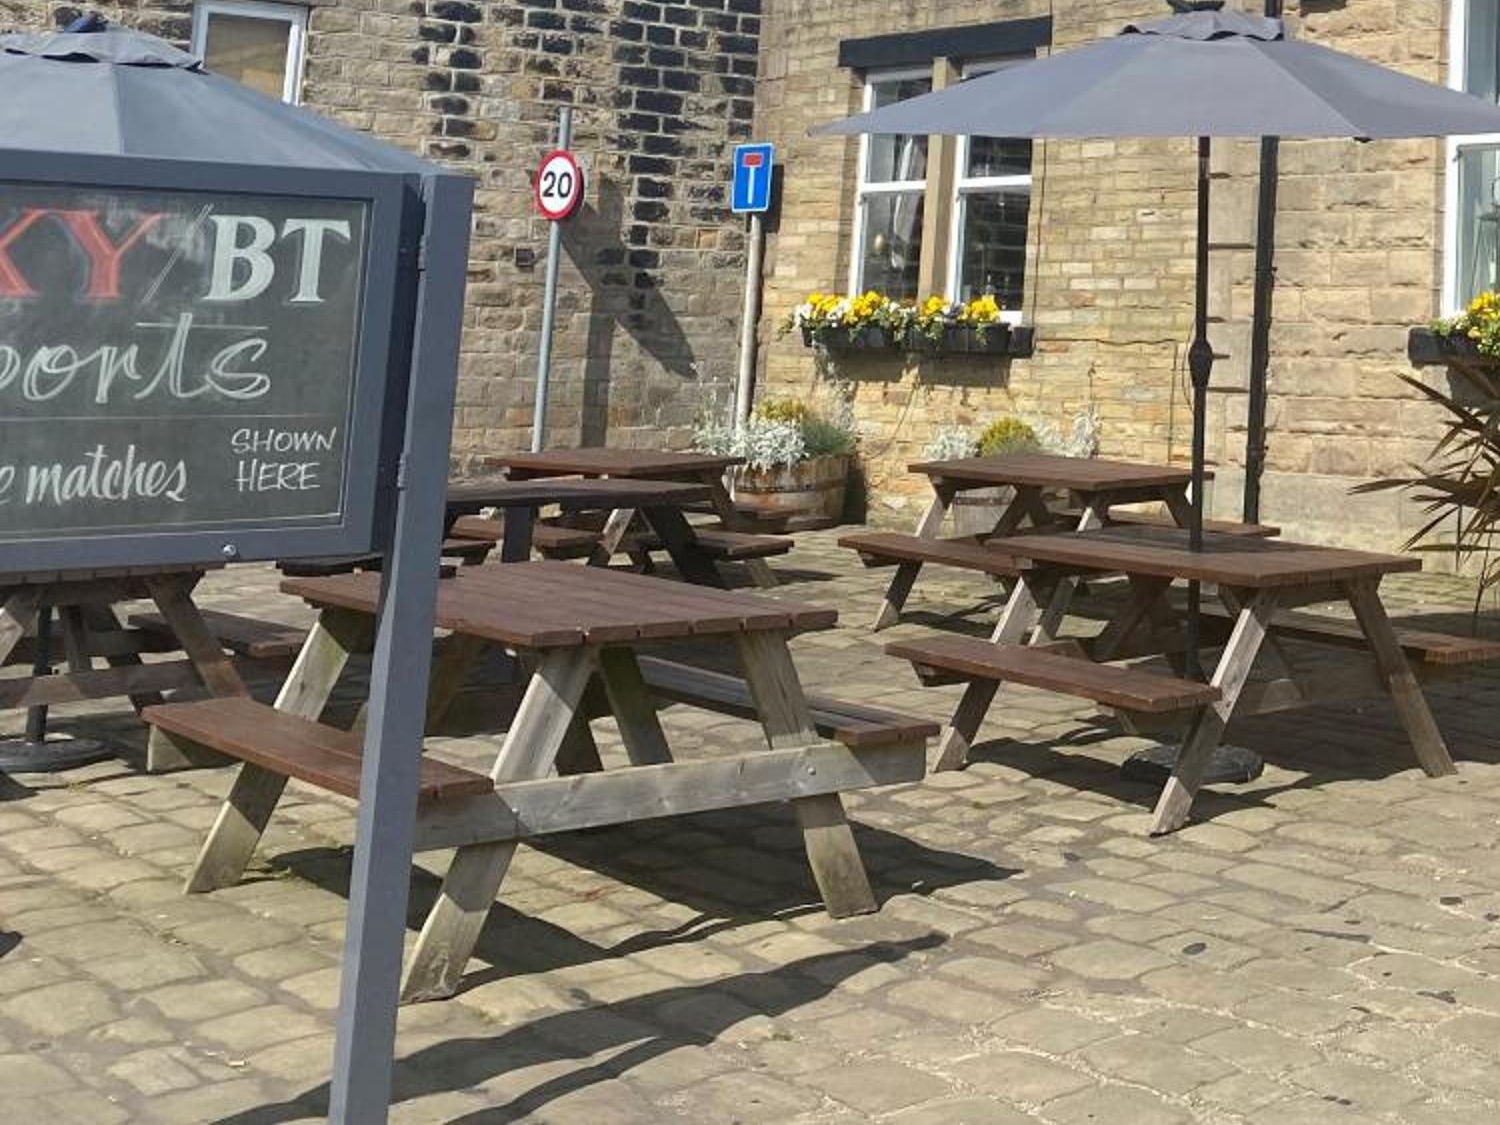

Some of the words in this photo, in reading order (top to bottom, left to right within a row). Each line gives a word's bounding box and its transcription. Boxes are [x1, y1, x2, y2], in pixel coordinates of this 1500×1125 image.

[541, 170, 573, 199] 20
[203, 213, 351, 303] BT
[230, 426, 338, 454] SHOWN
[25, 444, 189, 506] matches
[236, 461, 322, 492] HERE
